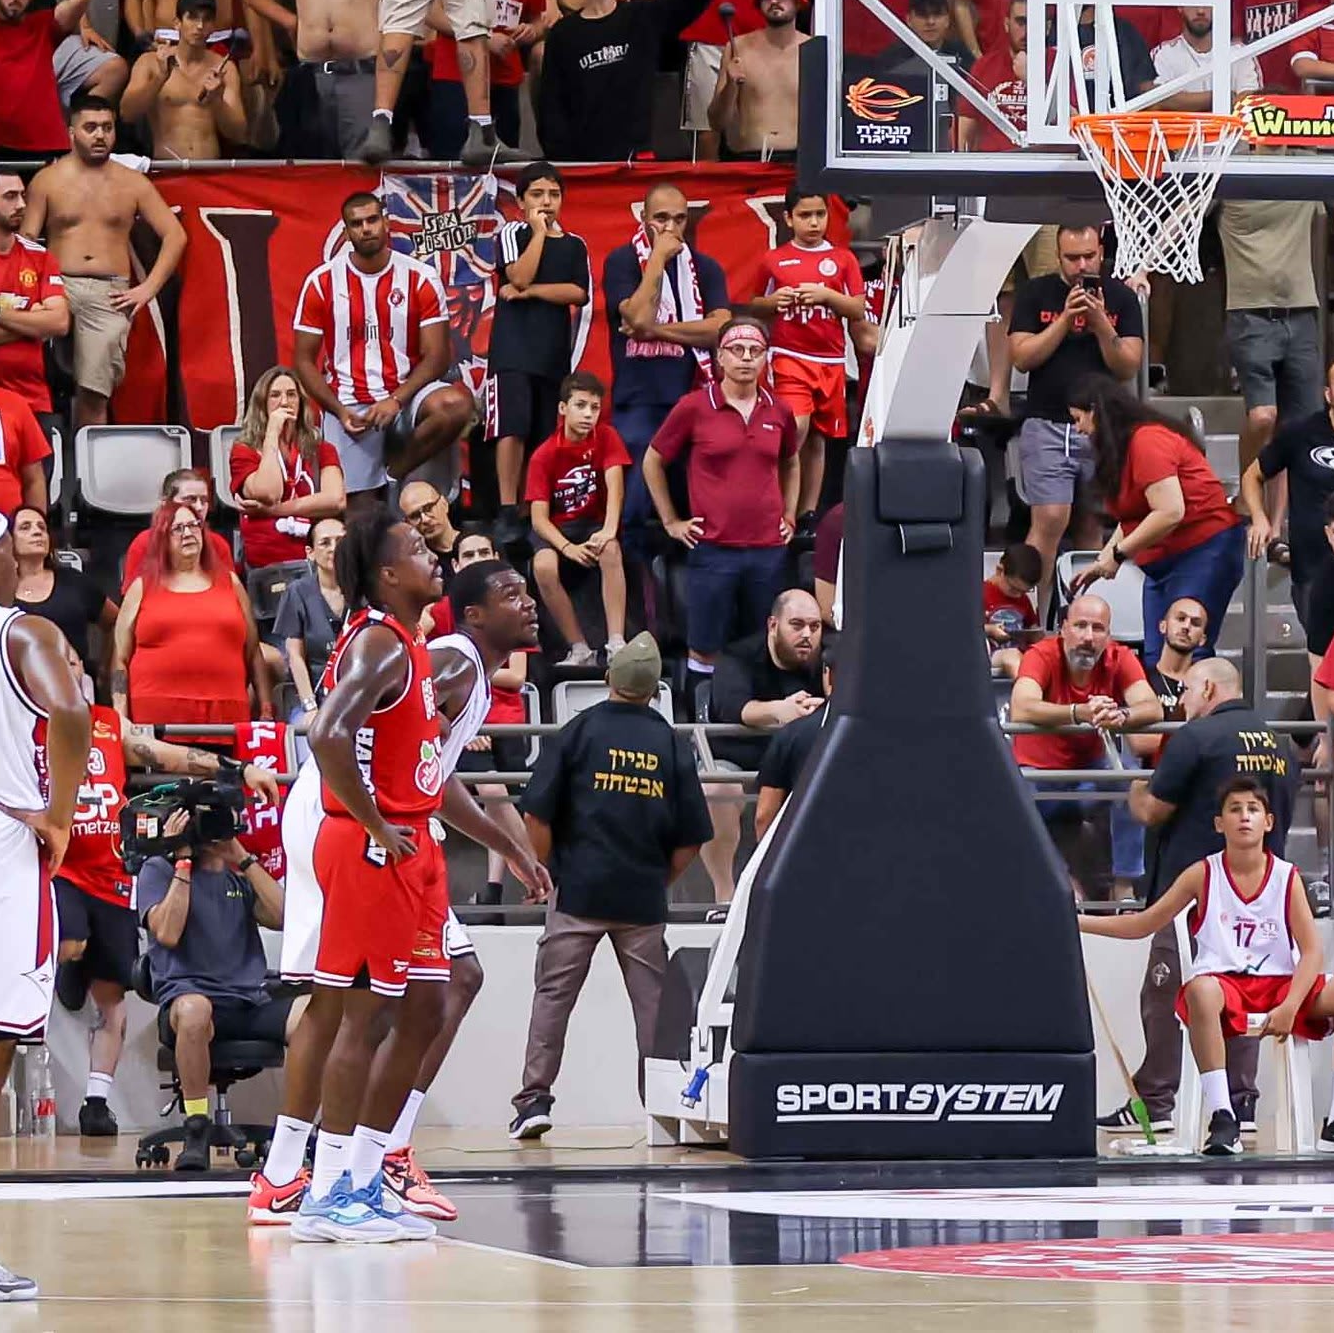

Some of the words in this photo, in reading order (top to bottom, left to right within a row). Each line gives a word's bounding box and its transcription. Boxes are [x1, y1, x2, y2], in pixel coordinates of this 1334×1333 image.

[855, 124, 912, 136] מנהלת
[858, 133, 909, 146] הליגה
[608, 748, 659, 773] פגיון
[593, 771, 664, 800] אבטחה
[1232, 923, 1257, 950] 17
[774, 1084, 1062, 1112] SPORTSYSTEM
